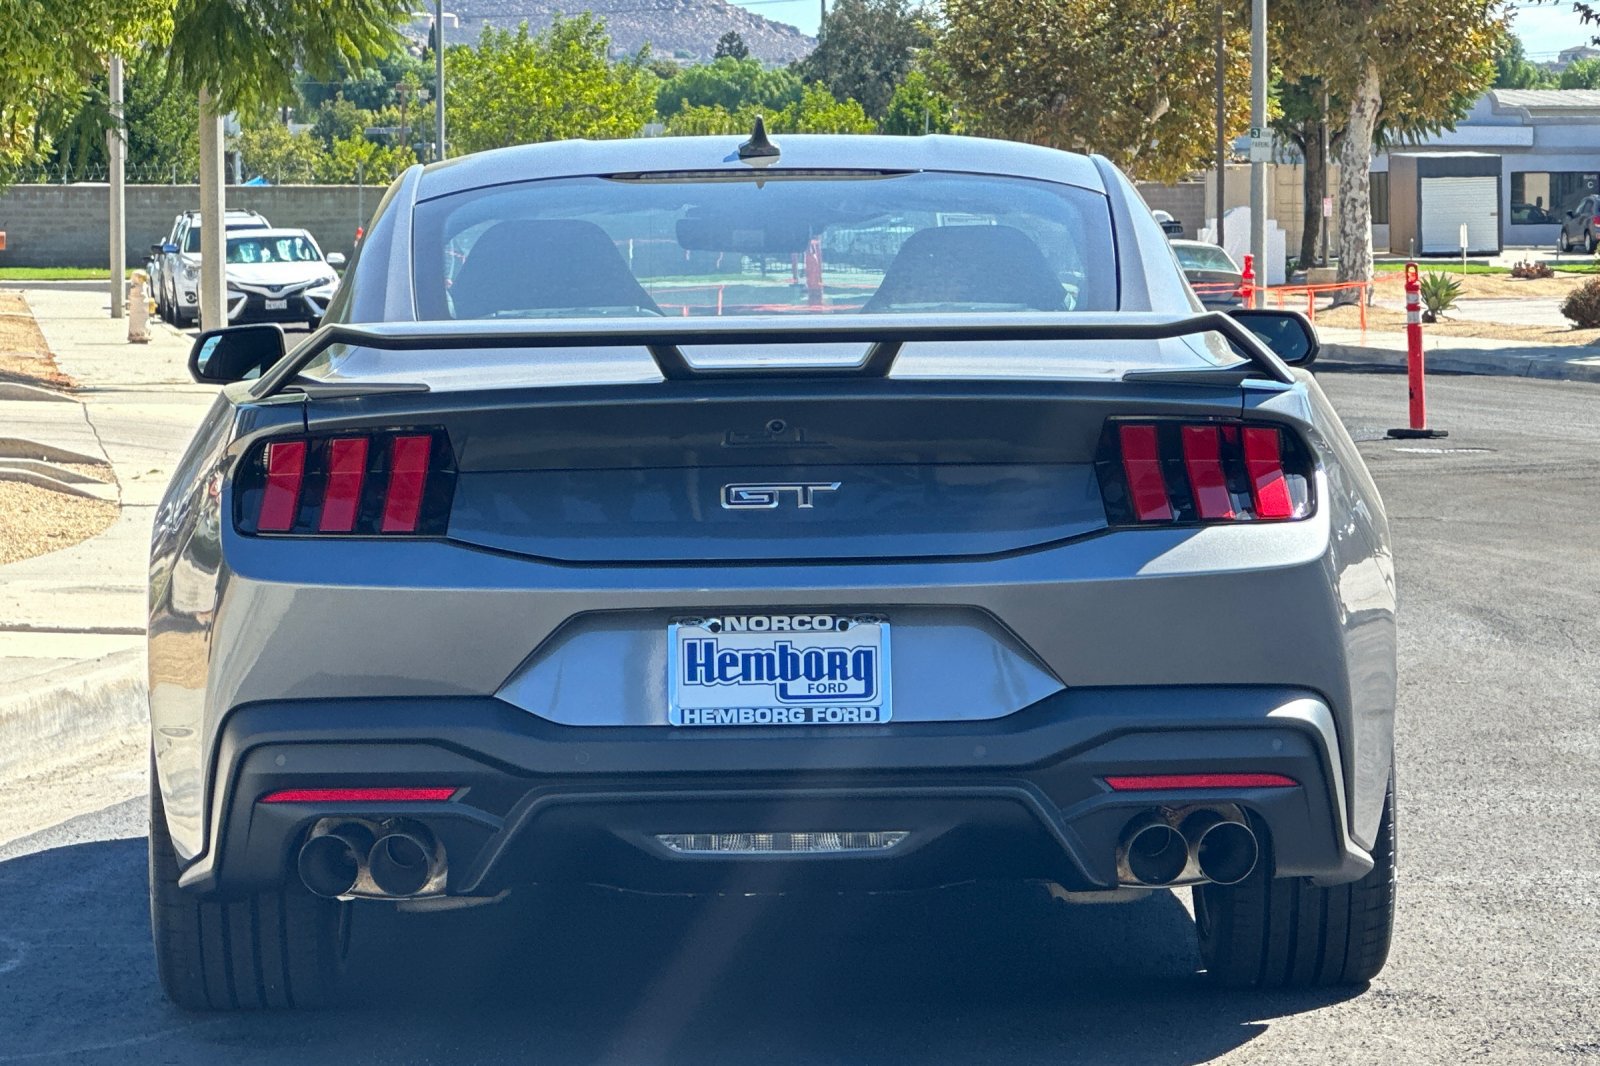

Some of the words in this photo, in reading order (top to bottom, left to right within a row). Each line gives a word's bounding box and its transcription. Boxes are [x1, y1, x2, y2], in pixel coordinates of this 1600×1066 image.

[720, 481, 842, 509] GT
[725, 615, 833, 631] NORCO
[683, 638, 877, 703] Hemborg
[808, 683, 848, 694] FORD
[683, 708, 805, 724] HEMBORG
[812, 707, 877, 723] FORD
